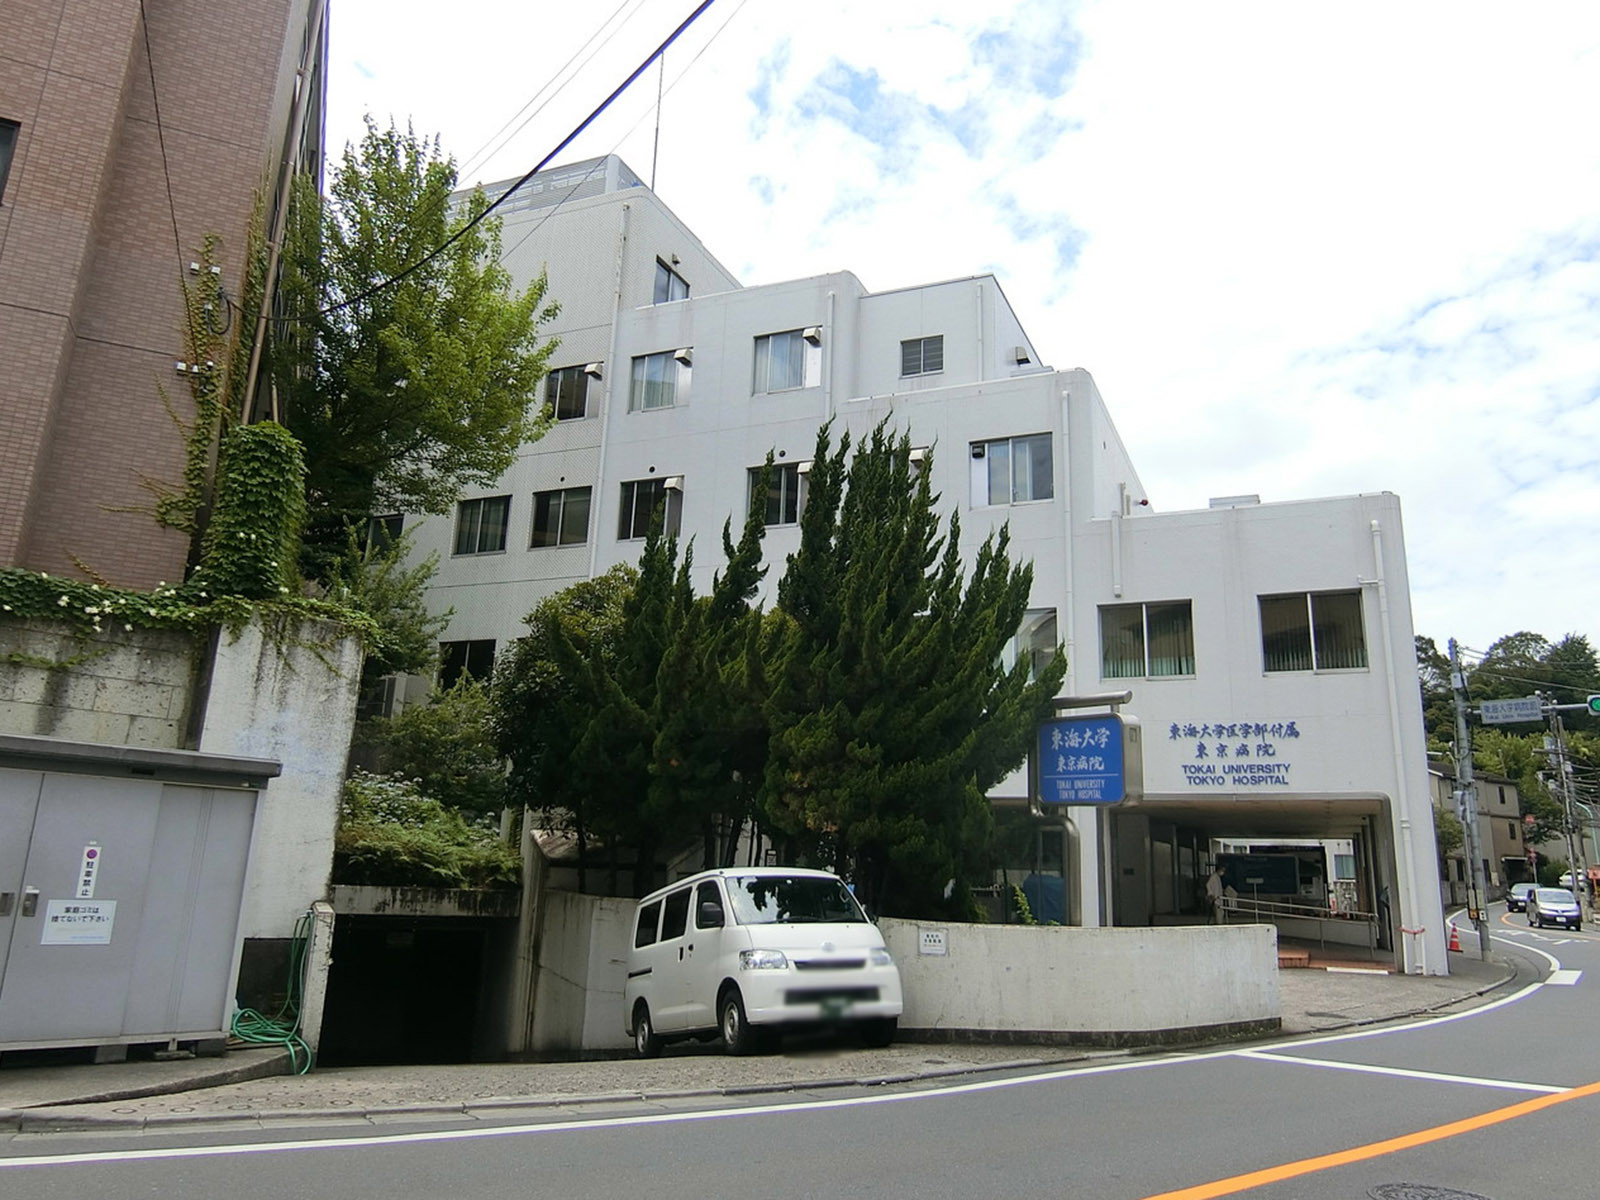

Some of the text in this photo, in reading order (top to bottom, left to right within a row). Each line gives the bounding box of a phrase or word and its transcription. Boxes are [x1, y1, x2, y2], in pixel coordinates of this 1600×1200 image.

[1169, 721, 1300, 743] 東海大学医学部付属
[1051, 727, 1111, 750] 東海大学
[1195, 741, 1276, 759] 東京病院
[1056, 754, 1105, 773] 東京病院
[1181, 763, 1291, 775] TOKAI UNIVERSITY
[1056, 779, 1105, 789] TOKAI UNIVERSITY
[1186, 775, 1290, 786] TOKYO HOSPITAL
[1059, 789, 1102, 800] TOKYO HOSPITAL
[81, 861, 95, 896] 駐車禁止
[64, 906, 100, 914] 家庭ゴミは
[51, 915, 110, 923] 捨てないで下さい
